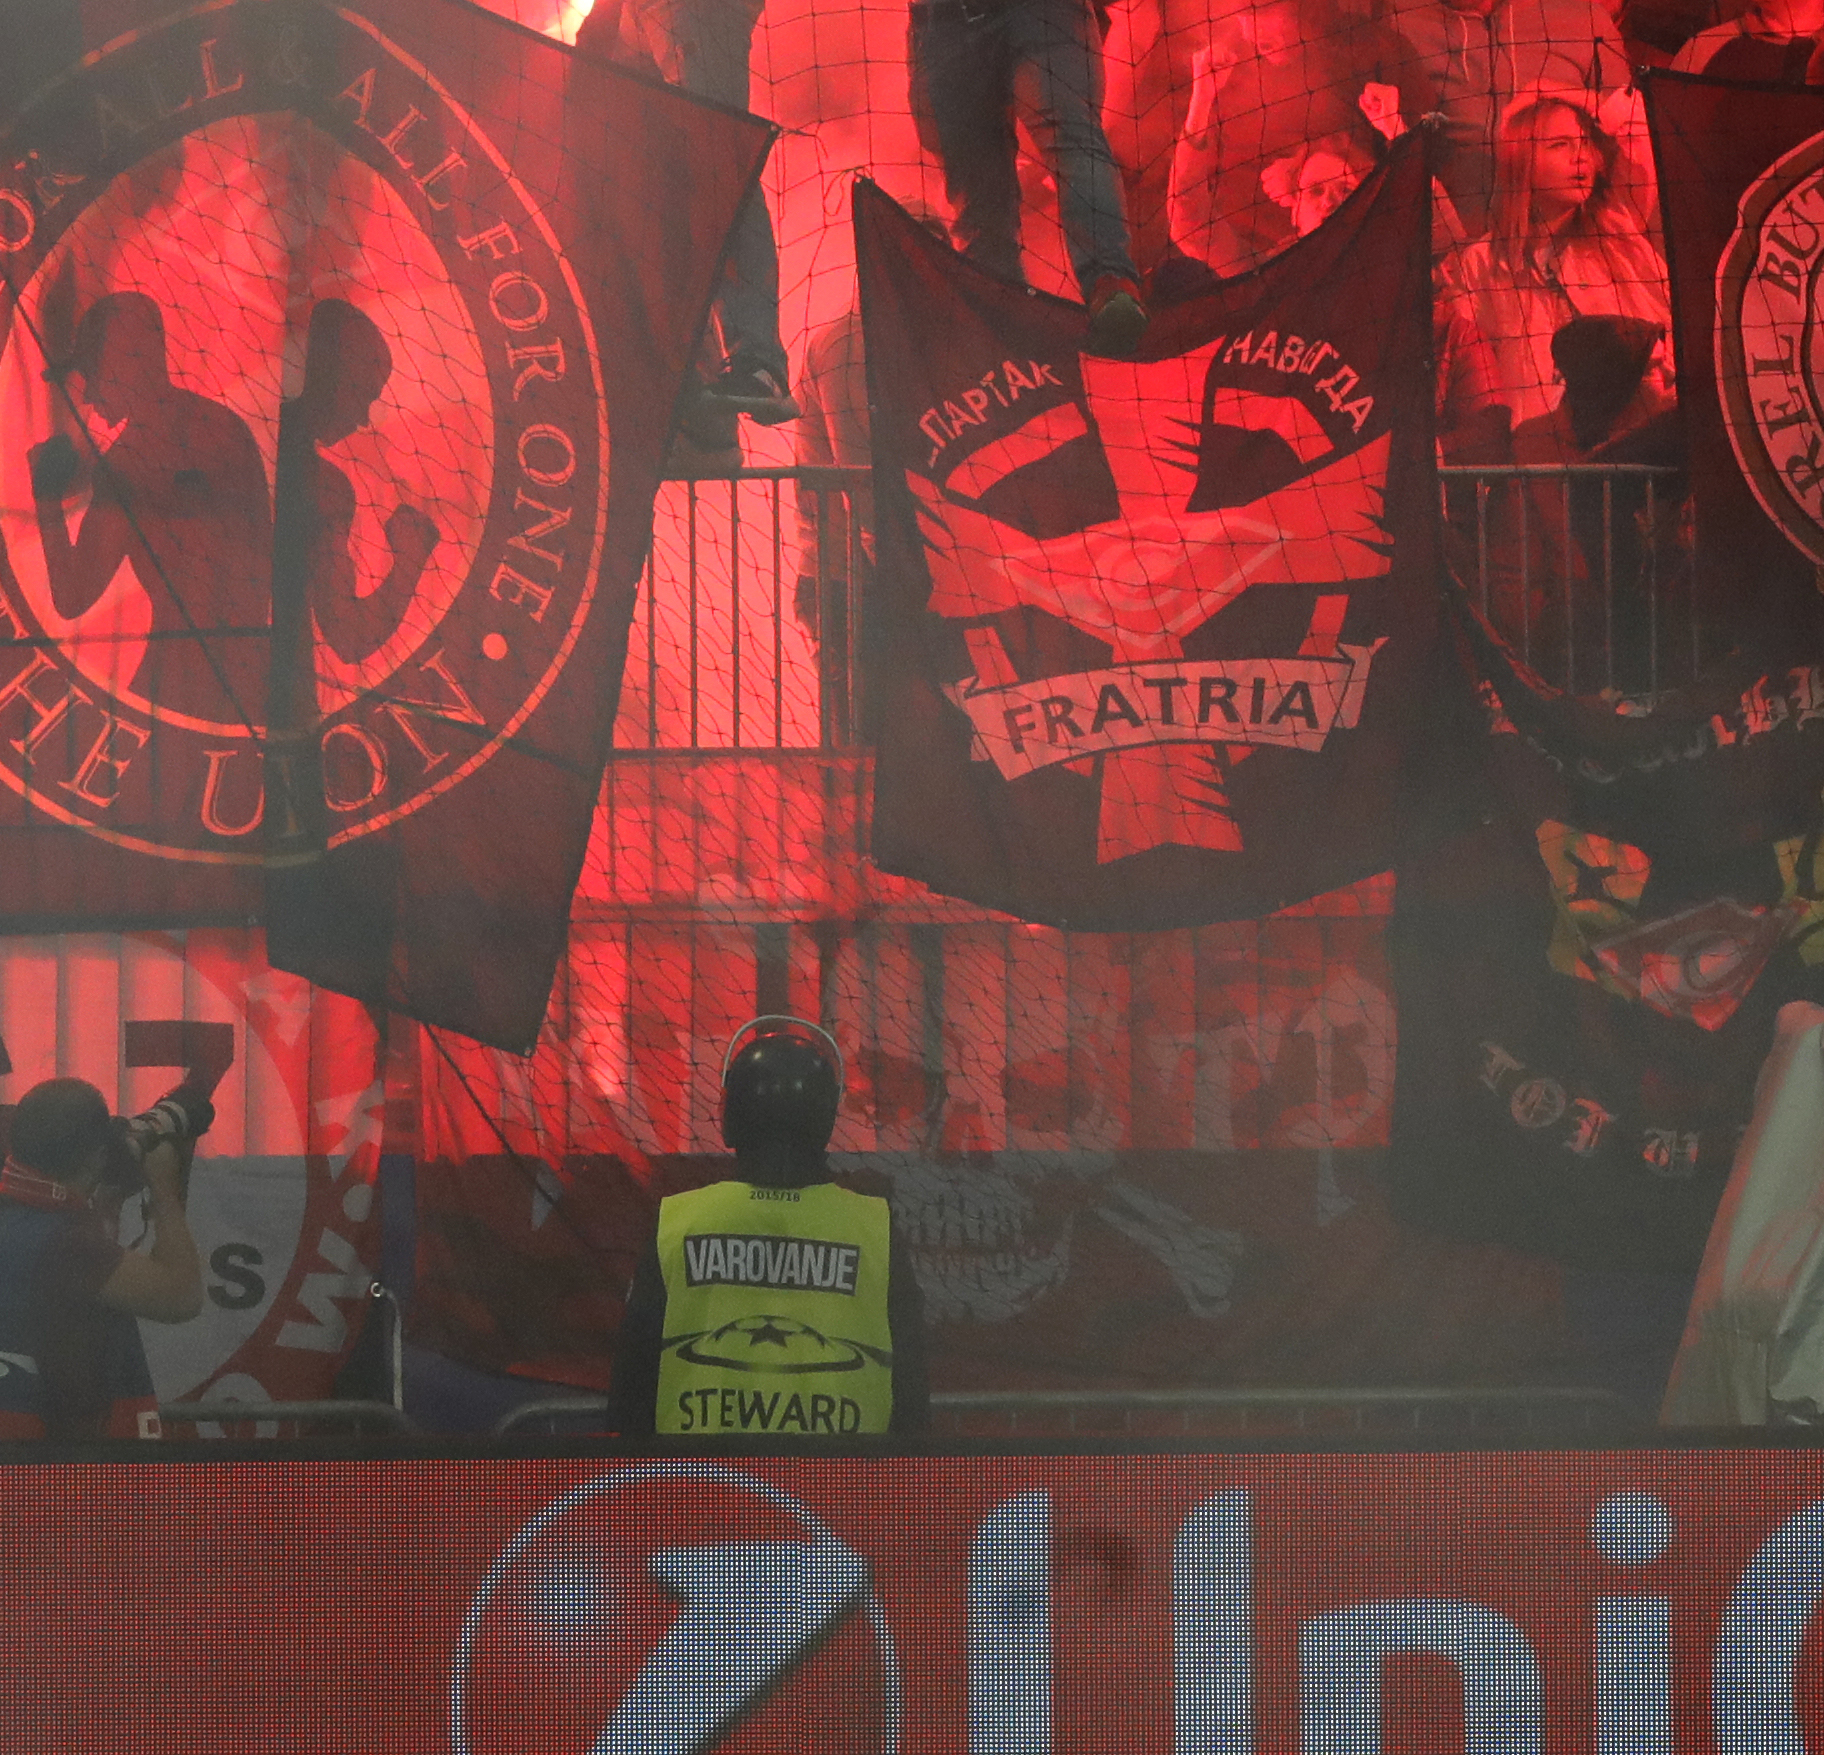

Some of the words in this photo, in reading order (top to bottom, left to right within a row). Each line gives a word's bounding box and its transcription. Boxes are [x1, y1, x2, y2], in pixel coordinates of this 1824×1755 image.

[342, 68, 469, 193] ALL
[456, 218, 566, 401] FOR
[918, 358, 1064, 469] ПАРТАК
[487, 427, 577, 623] ONE
[1001, 675, 1321, 755] FRATRIA
[684, 1236, 858, 1294] VAROVANJE
[678, 1389, 862, 1435] STEWARD
